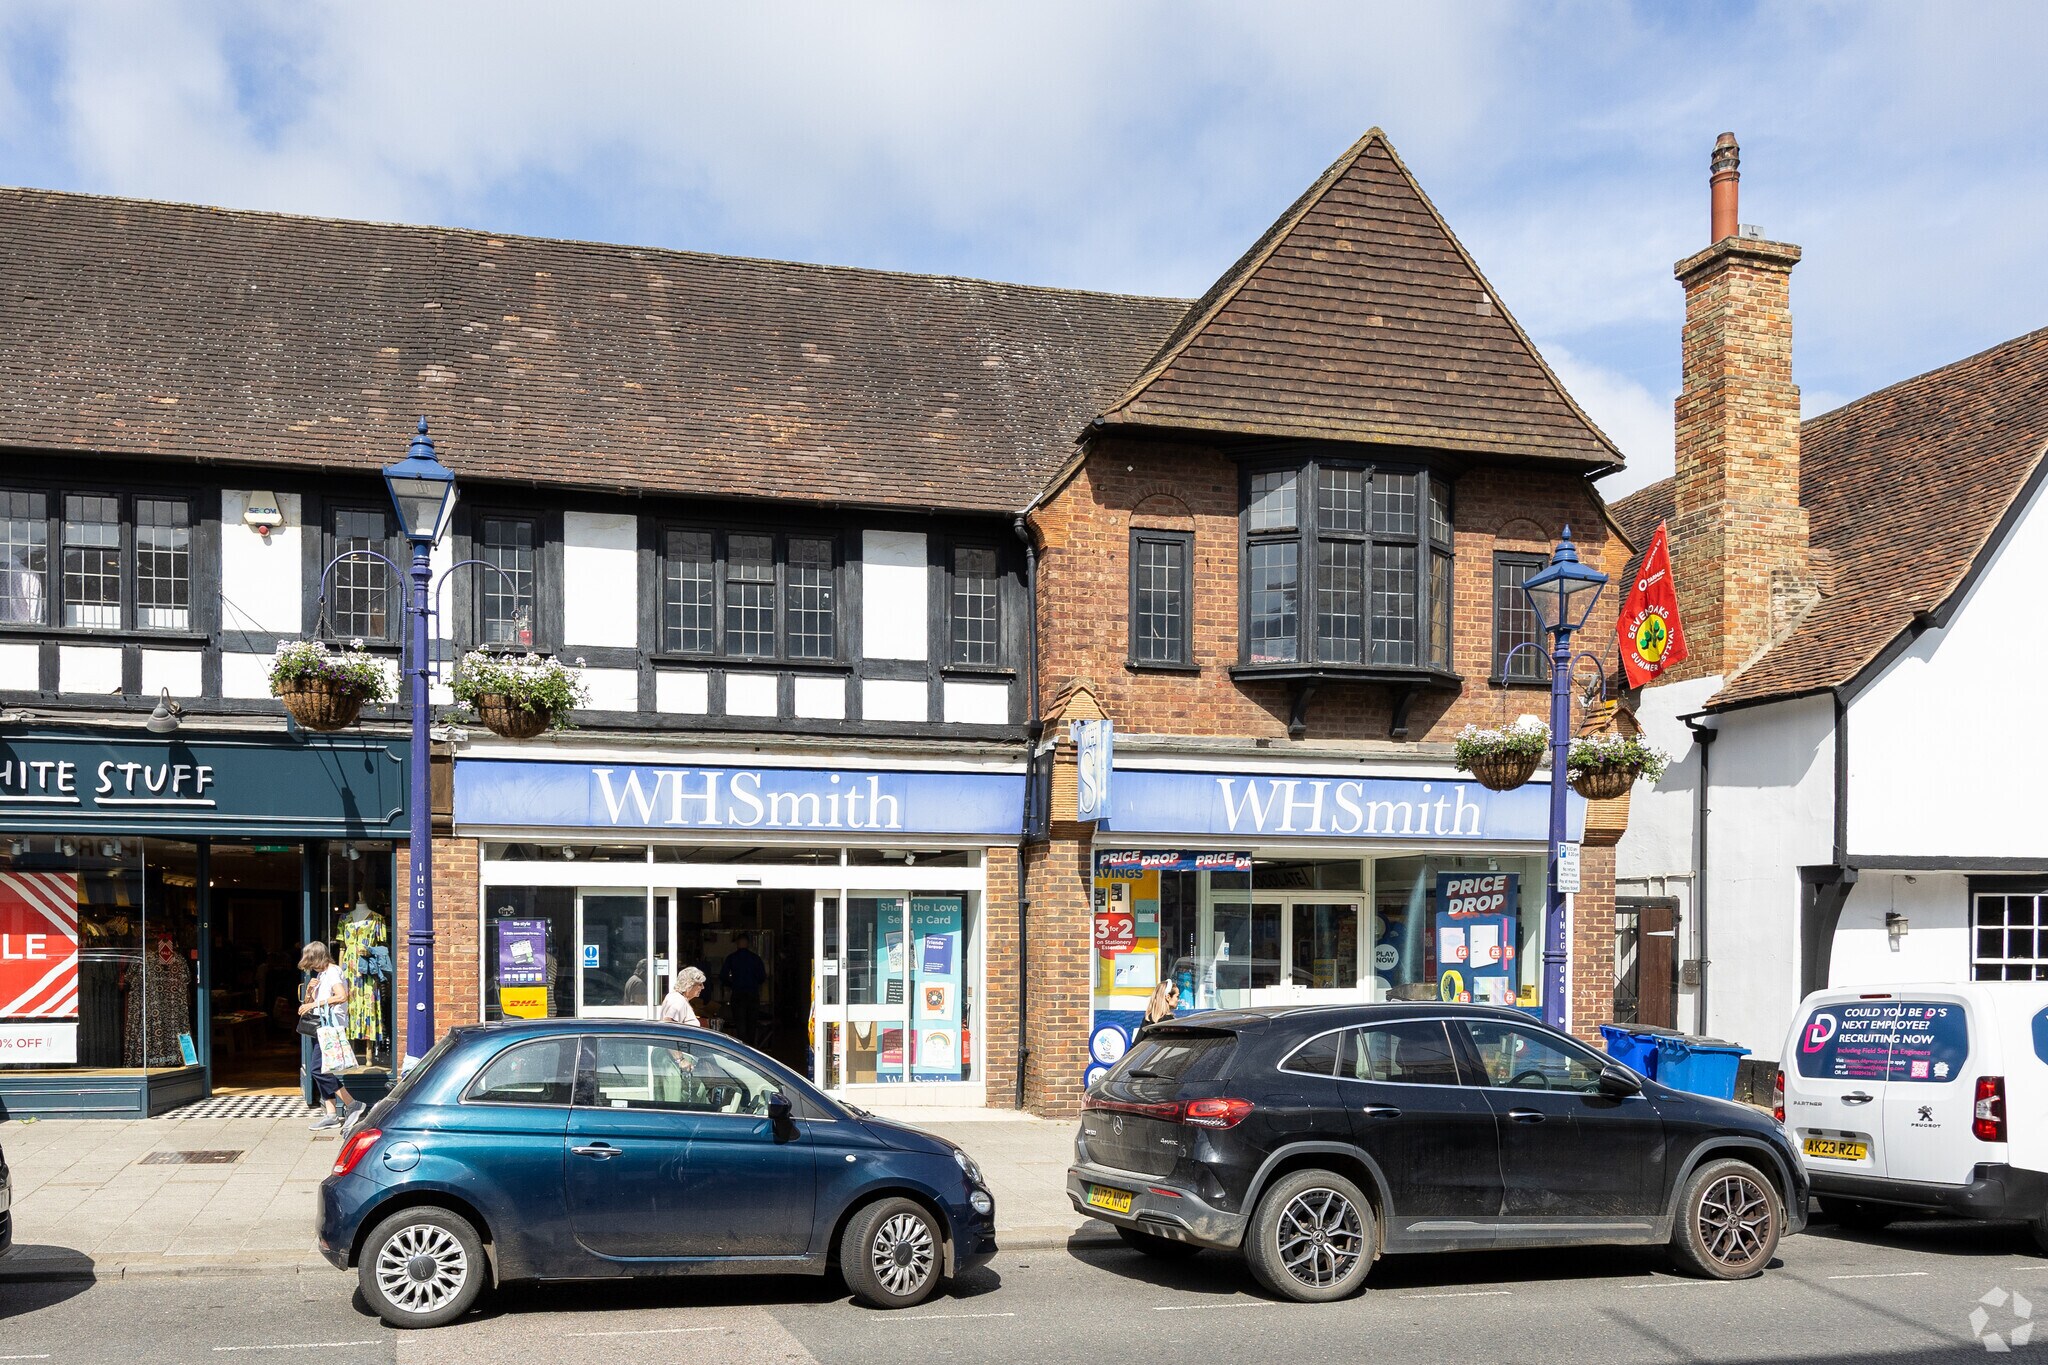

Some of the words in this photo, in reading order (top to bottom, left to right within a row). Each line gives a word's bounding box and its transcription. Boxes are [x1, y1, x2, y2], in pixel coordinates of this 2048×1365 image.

[1631, 652, 1659, 671] SUMMER
[1660, 627, 1674, 665] STIVAL
[95, 761, 213, 793] STUFF
[592, 769, 903, 829] WHSmith
[1216, 778, 1482, 836] WHSmith
[1100, 851, 1141, 865] PRICE
[1141, 853, 1179, 866] DROP
[1195, 852, 1235, 866] PRICE
[1446, 875, 1506, 896] PRICE
[913, 903, 930, 912] the
[933, 903, 958, 912] Love
[1448, 894, 1504, 914] DROP
[926, 915, 951, 924] Card
[1095, 919, 1110, 939] 3
[1118, 919, 1133, 938] 2
[1844, 1008, 1880, 1017] COULD
[1883, 1008, 1906, 1017] YOU
[1908, 1008, 1923, 1017] BE
[1841, 1021, 1868, 1030] NEXT
[1870, 1021, 1930, 1030] EMPLOYEE?
[16, 1038, 42, 1048] OFF
[1839, 1034, 1900, 1044] RECRUITING
[1902, 1035, 1935, 1044] NOW
[1837, 1047, 1861, 1055] Including
[1900, 1048, 1931, 1056] Engineers
[1807, 1140, 1835, 1154] AK23
[1839, 1142, 1861, 1156] RZL
